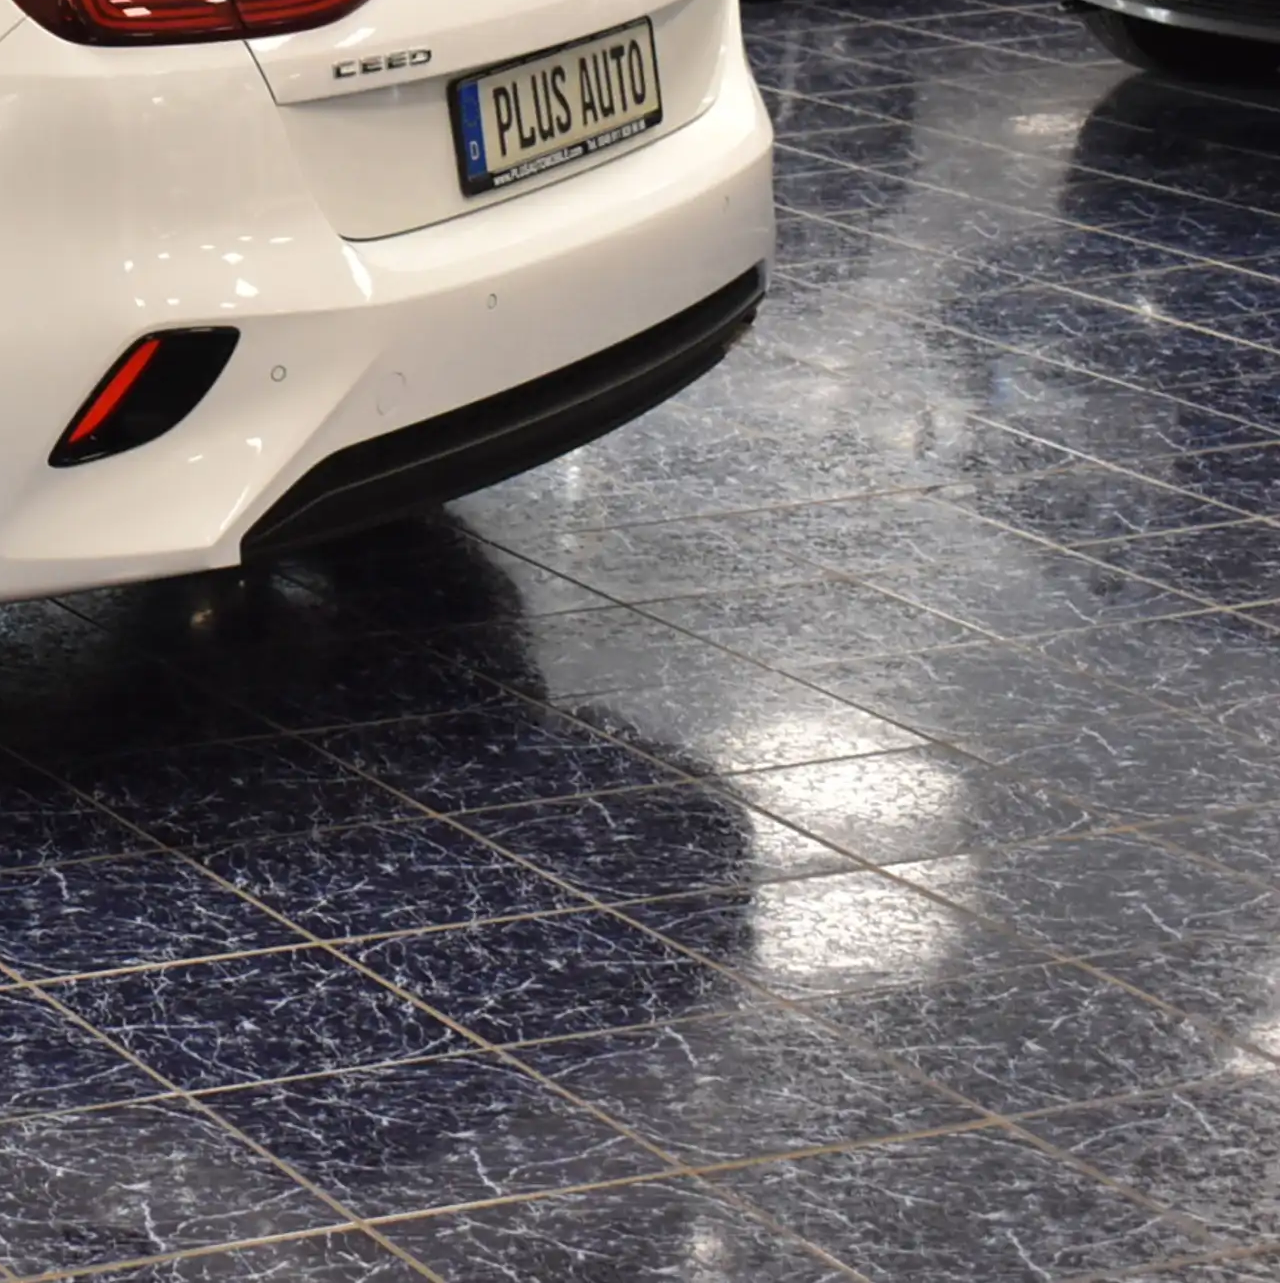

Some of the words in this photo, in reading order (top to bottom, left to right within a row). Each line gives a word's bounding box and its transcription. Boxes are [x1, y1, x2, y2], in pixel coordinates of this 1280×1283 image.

[332, 45, 432, 79] CEED
[493, 65, 572, 157] PLUS
[579, 38, 647, 126] AUTO
[470, 139, 480, 161] D
